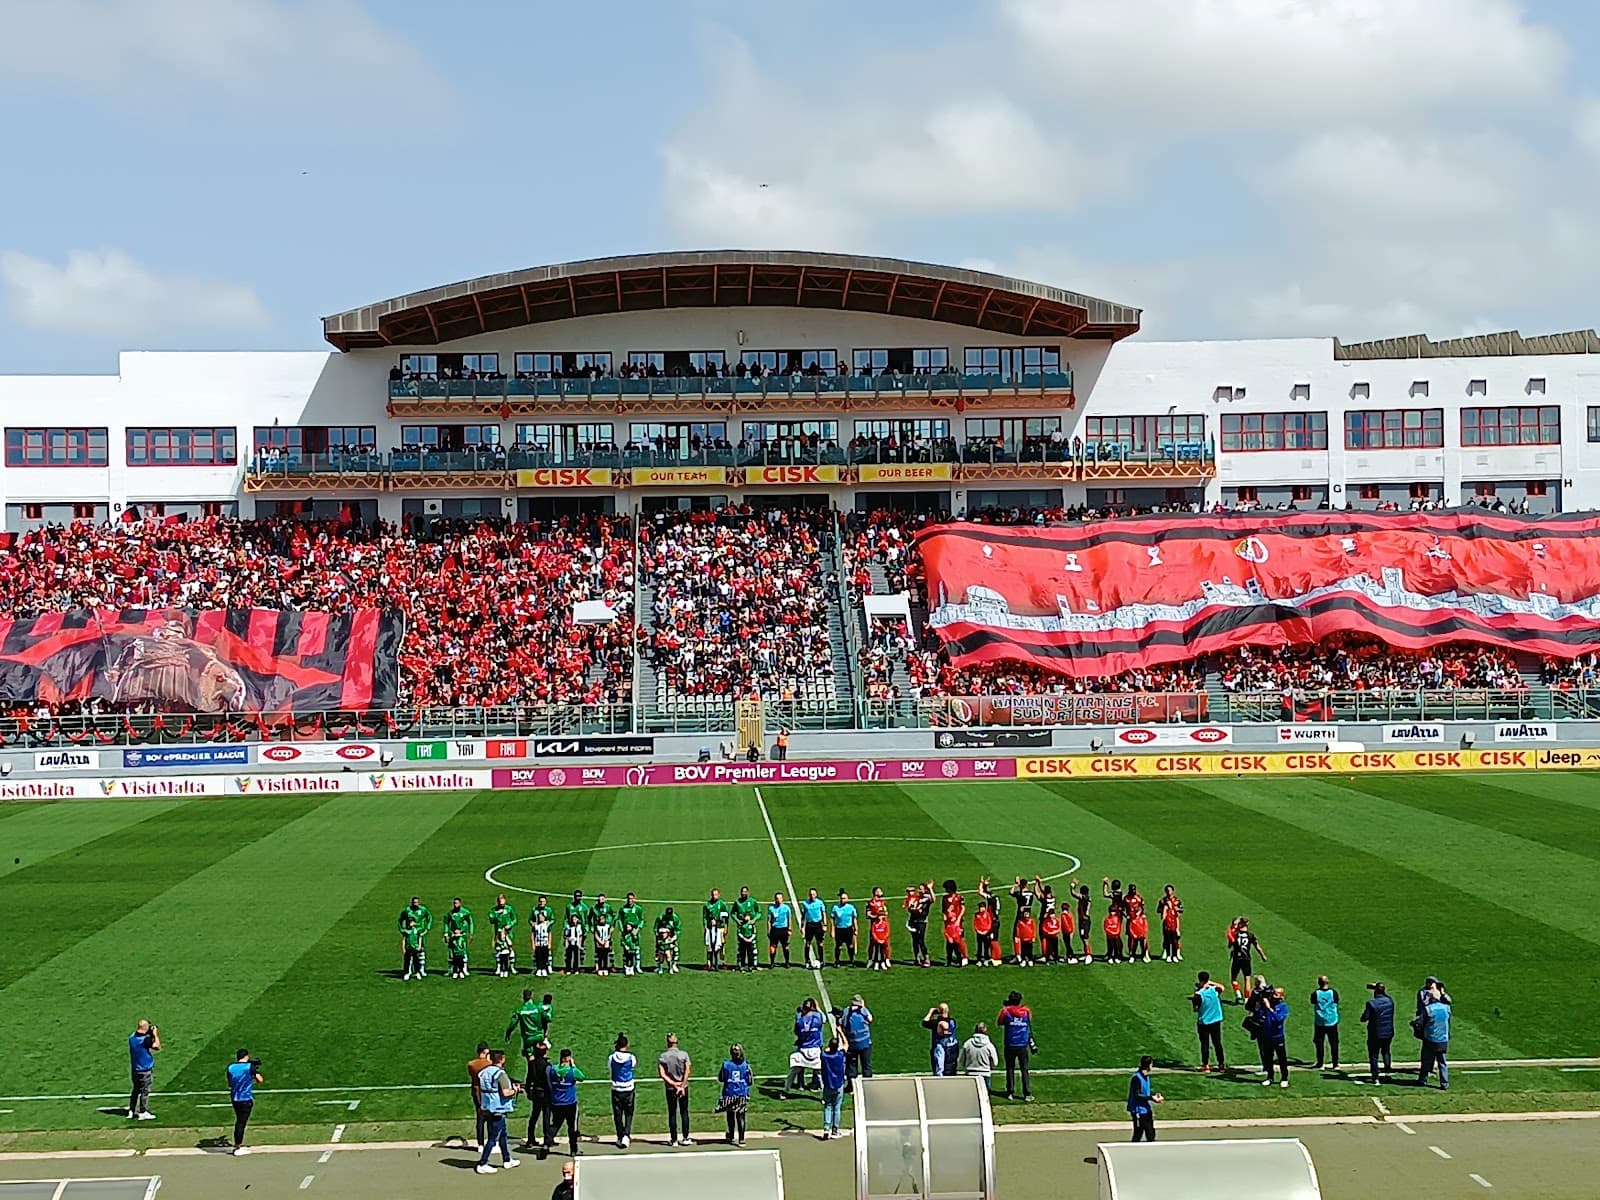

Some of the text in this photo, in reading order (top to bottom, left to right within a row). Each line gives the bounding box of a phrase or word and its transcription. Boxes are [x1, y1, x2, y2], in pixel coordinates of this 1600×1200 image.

[534, 469, 592, 485] CISK
[650, 472, 707, 481] OUR TEAM
[763, 466, 820, 482] CISK
[878, 468, 933, 478] OUR BEER
[1333, 484, 1342, 493] G
[1564, 479, 1572, 487] H
[505, 498, 513, 507] C
[956, 490, 963, 501] F
[113, 503, 122, 512] B
[1392, 725, 1440, 737] LAVAZZA
[1499, 724, 1548, 737] LAVAZZA
[416, 744, 433, 758] FIAT
[501, 743, 516, 756] FIAT
[40, 753, 90, 766] LAVAZZA
[1156, 757, 1201, 773] CISK
[1220, 756, 1267, 771] CISK
[1285, 755, 1332, 771] CISK
[1350, 754, 1396, 769] CISK
[1415, 752, 1461, 767] CISK
[1480, 751, 1526, 767] CISK
[1540, 750, 1581, 766] Jeep
[674, 764, 836, 780] BOV Premier League
[902, 762, 924, 771] BOV
[974, 761, 997, 771] BOV
[1025, 759, 1072, 774] CISK
[1091, 758, 1137, 773] CISK
[511, 770, 535, 780] BOV
[582, 769, 604, 778] BOV
[122, 780, 206, 795] VisitMalta
[256, 776, 339, 791] VisitMalta
[391, 774, 474, 788] VisitMalta
[1, 783, 75, 797] isitMalta
[1025, 895, 1031, 905] 7
